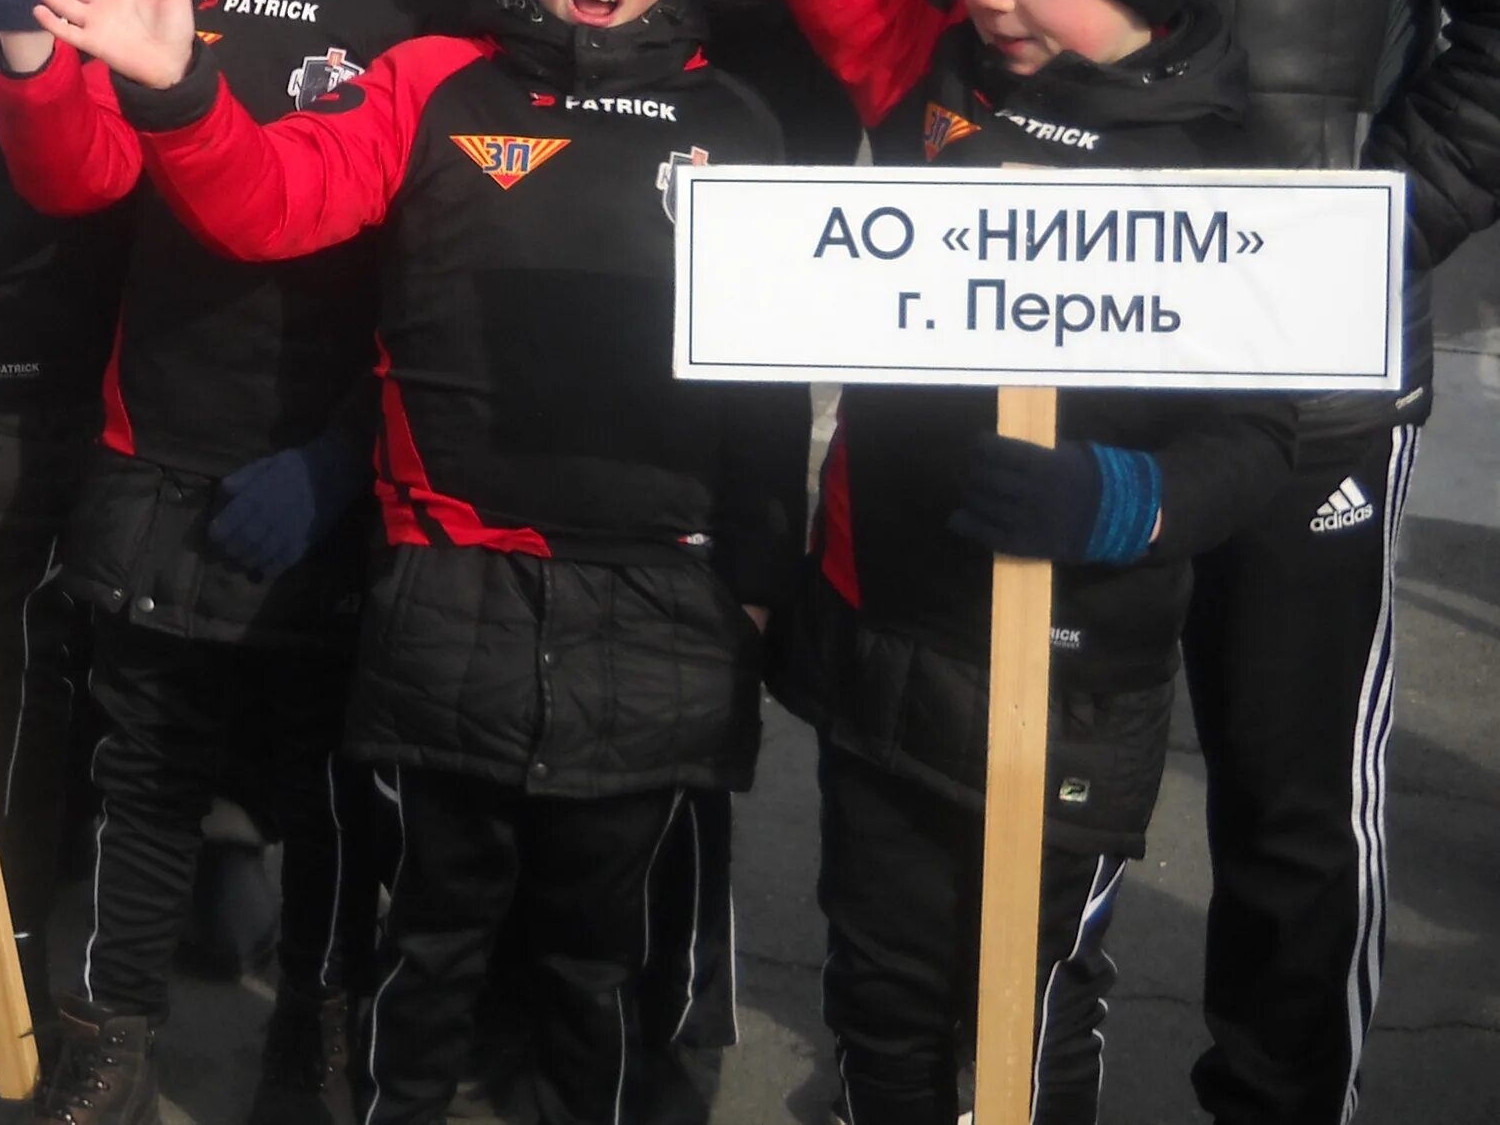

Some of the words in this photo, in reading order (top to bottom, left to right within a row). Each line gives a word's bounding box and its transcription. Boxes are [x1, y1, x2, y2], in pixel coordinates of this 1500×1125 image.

[812, 206, 916, 260] АО
[941, 208, 1266, 263] «НИИПМ»
[897, 291, 936, 330] г.
[966, 278, 1183, 347] Пермь
[1310, 503, 1374, 533] adidas
